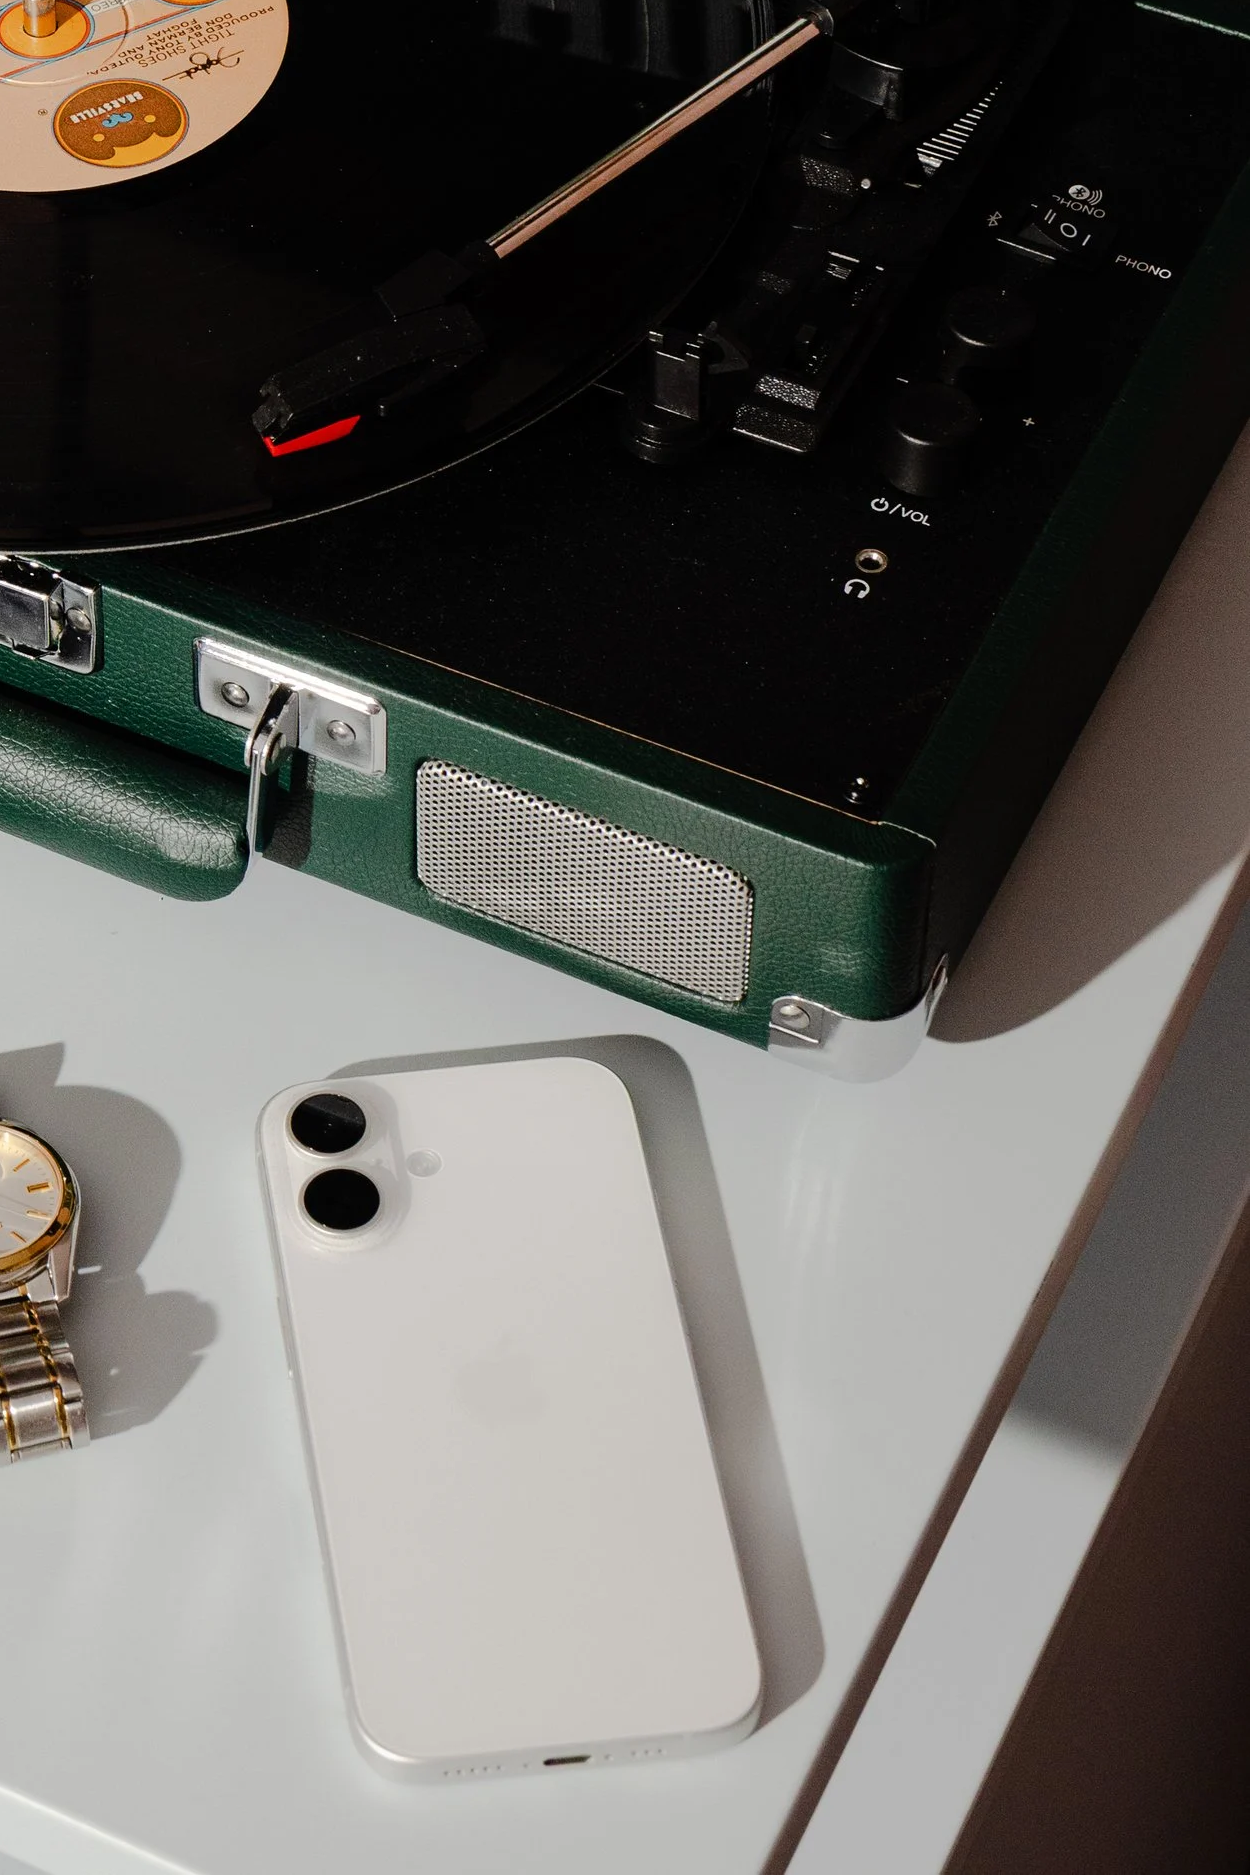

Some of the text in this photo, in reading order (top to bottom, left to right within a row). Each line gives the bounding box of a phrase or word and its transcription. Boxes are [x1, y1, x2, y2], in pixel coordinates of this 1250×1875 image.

[145, 17, 197, 41] FOGHAT
[205, 5, 275, 34] PRODUCED
[117, 12, 233, 58] DON BERMAN AND
[137, 28, 234, 68] TIGHT SHOES
[147, 38, 182, 55] TONY
[186, 31, 202, 42] BY
[69, 90, 144, 124] BEARSVILLE
[1114, 254, 1172, 280] PHONO
